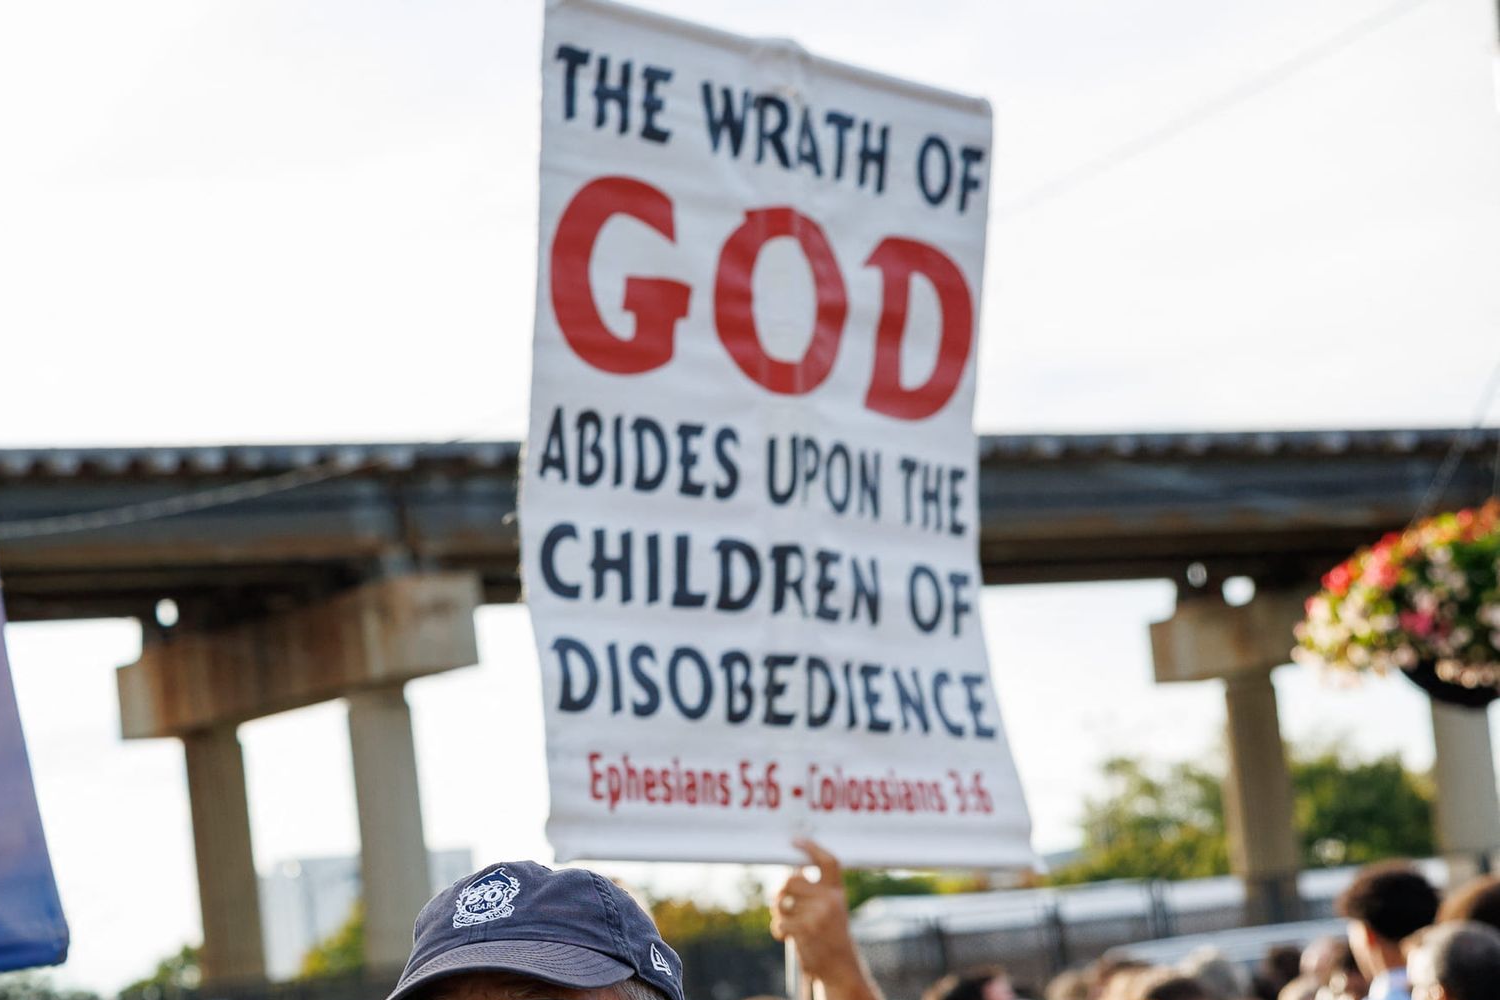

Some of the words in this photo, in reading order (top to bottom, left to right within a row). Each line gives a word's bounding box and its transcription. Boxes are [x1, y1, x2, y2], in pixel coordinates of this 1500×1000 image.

[555, 44, 674, 144] THE
[700, 80, 889, 195] WRATH
[916, 135, 986, 215] OF
[549, 175, 974, 421] GOD
[539, 405, 741, 499] ABIDES
[767, 435, 881, 521] UPON
[899, 458, 967, 536] THE
[539, 522, 880, 626] CHILDREN
[908, 565, 970, 637] OF
[552, 637, 997, 739] DISOBEDIENCE
[588, 752, 731, 813] Ephesians
[739, 760, 781, 809] 5:6
[806, 764, 942, 814] Colossians
